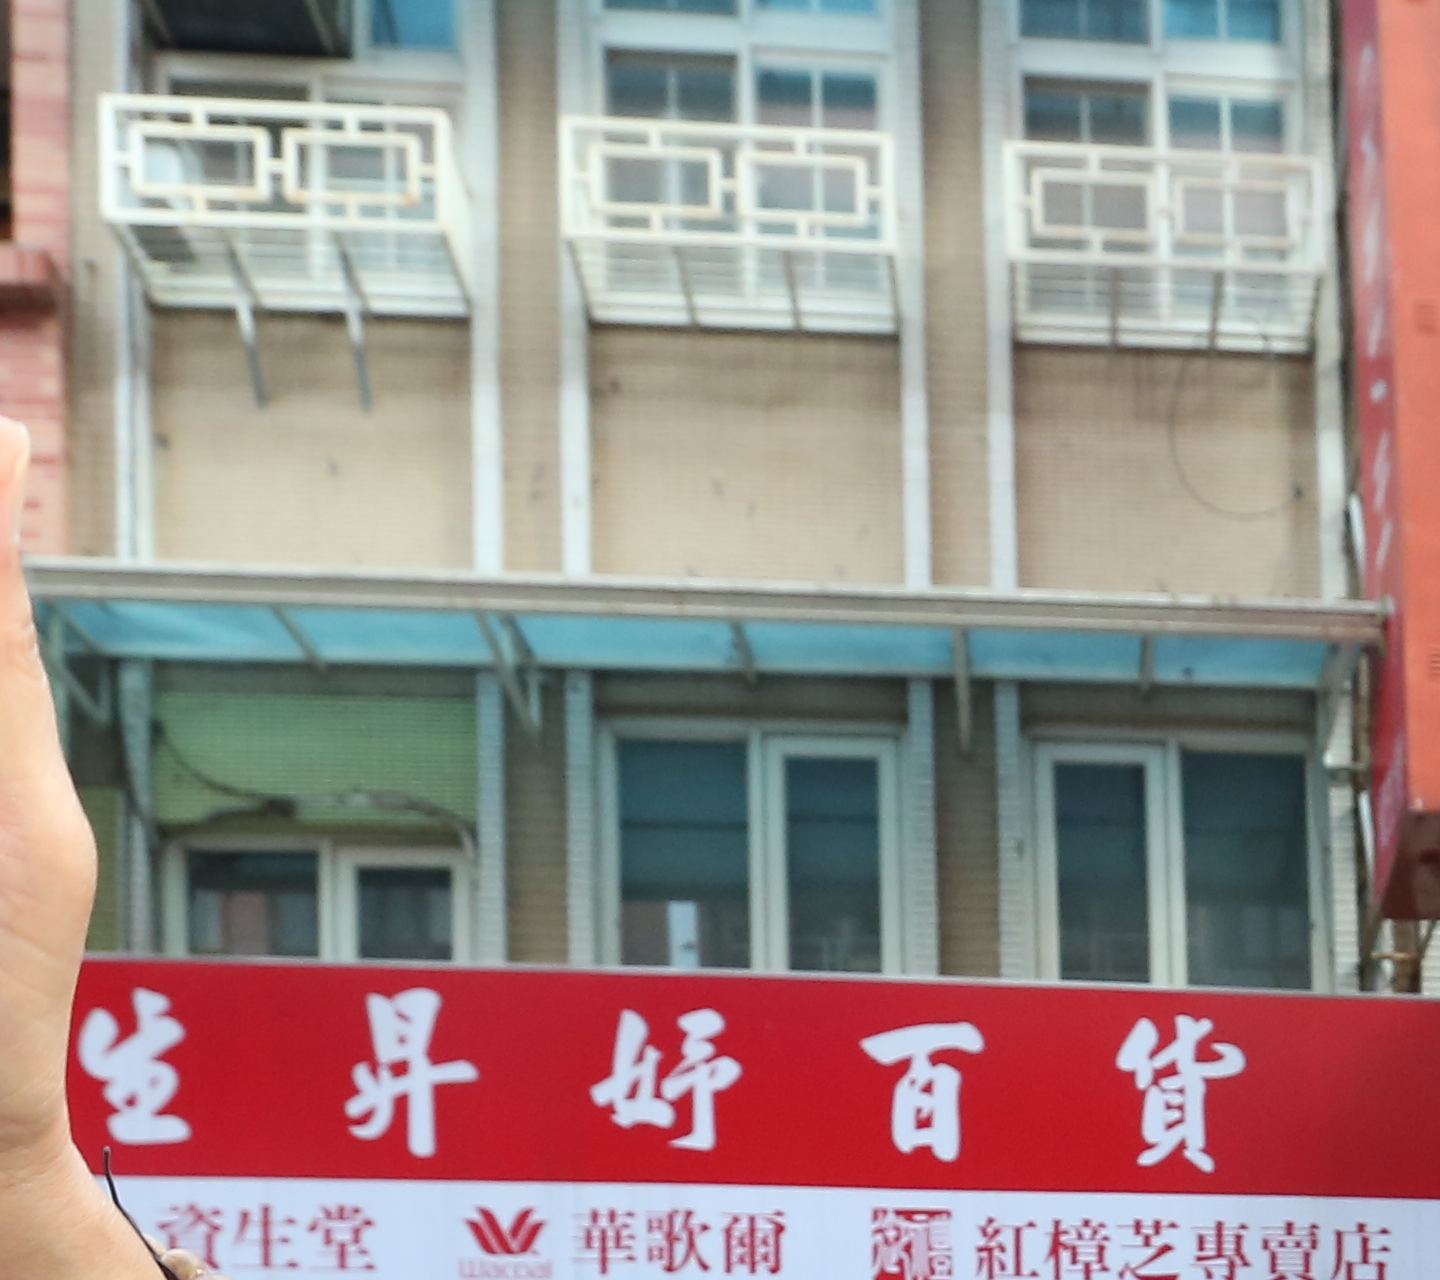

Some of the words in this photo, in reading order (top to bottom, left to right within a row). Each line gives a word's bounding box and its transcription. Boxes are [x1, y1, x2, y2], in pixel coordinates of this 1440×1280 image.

[159, 1203, 377, 1272] 資生堂
[572, 1206, 788, 1276] 華歌爾
